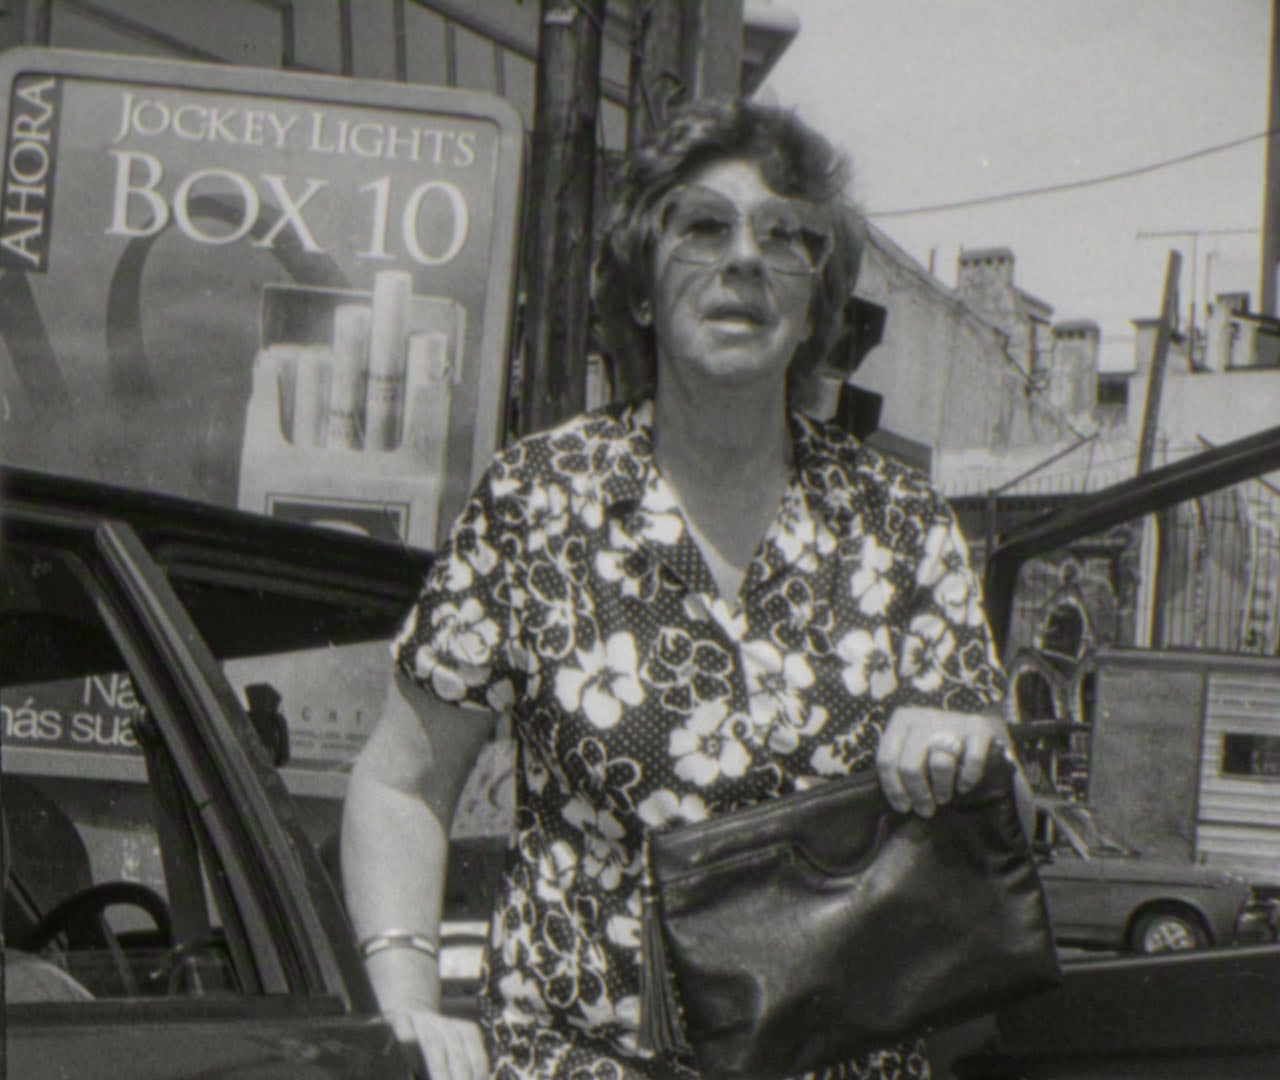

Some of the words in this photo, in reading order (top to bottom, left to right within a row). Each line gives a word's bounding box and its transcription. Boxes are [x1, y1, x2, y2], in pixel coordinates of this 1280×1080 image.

[0, 77, 57, 266] AHORA
[114, 93, 298, 148] JOCKEY
[311, 111, 476, 168] LIGHTS
[105, 149, 330, 256] BOX
[354, 173, 469, 267] 10
